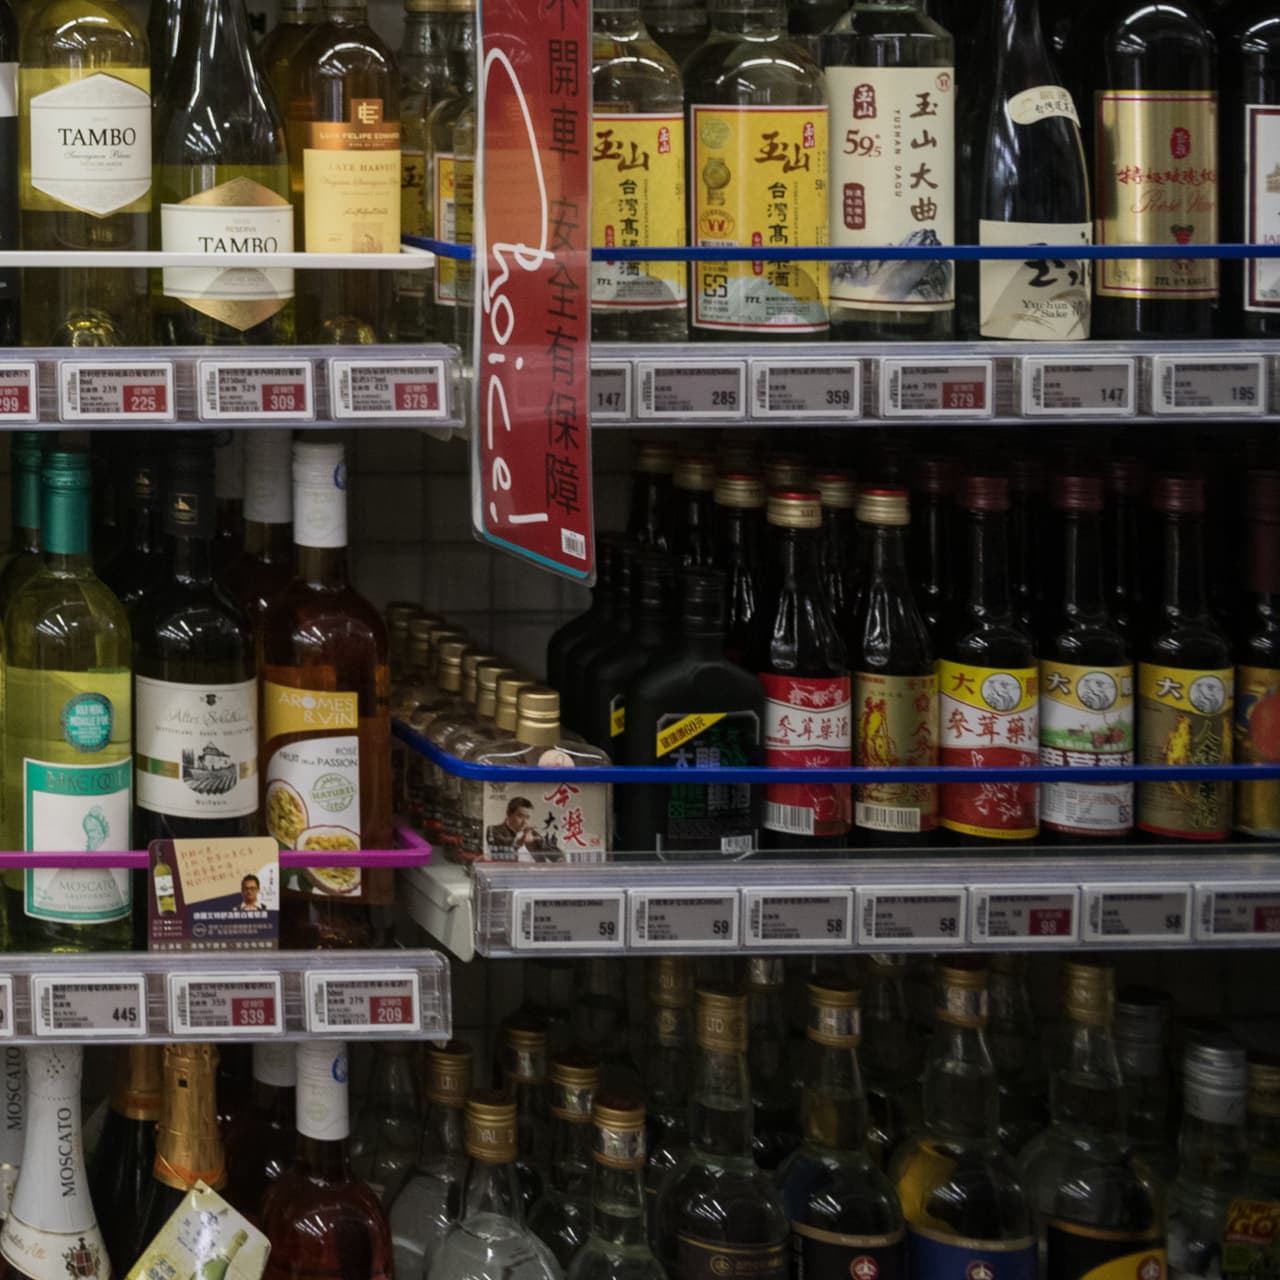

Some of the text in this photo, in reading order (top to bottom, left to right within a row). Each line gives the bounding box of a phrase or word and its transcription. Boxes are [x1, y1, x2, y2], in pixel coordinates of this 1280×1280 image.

[57, 128, 136, 146] TAMBO
[592, 129, 651, 173] 玉山
[754, 130, 810, 173] 玉山
[910, 91, 939, 222] 玉山大曲
[198, 236, 278, 253] TAMBO
[270, 395, 295, 410] 309
[826, 389, 850, 405] 359
[279, 751, 358, 768] FRUIT PASSION
[60, 879, 116, 892] MOSCATO
[598, 919, 616, 936] 59
[112, 1007, 136, 1022] 445
[58, 1107, 73, 1198] MOSCATO
